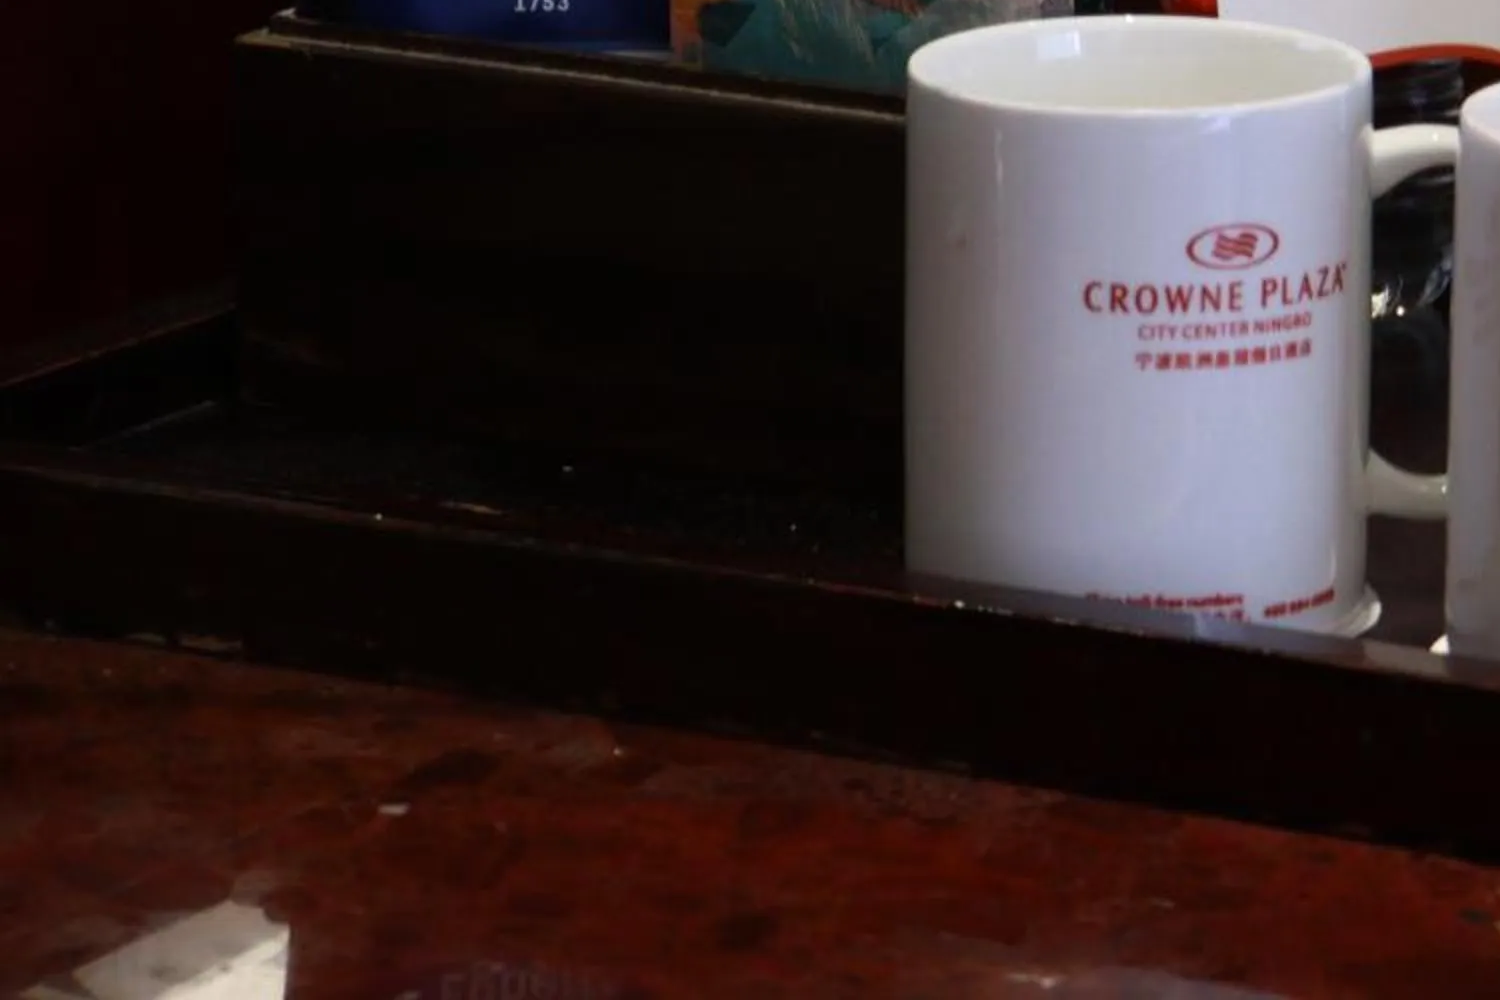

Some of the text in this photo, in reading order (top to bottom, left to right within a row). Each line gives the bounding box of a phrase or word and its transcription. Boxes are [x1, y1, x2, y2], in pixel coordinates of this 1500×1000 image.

[1083, 262, 1347, 315] CROWNE PLAZA
[1137, 323, 1179, 342] CITY
[1182, 320, 1249, 341] CENTER
